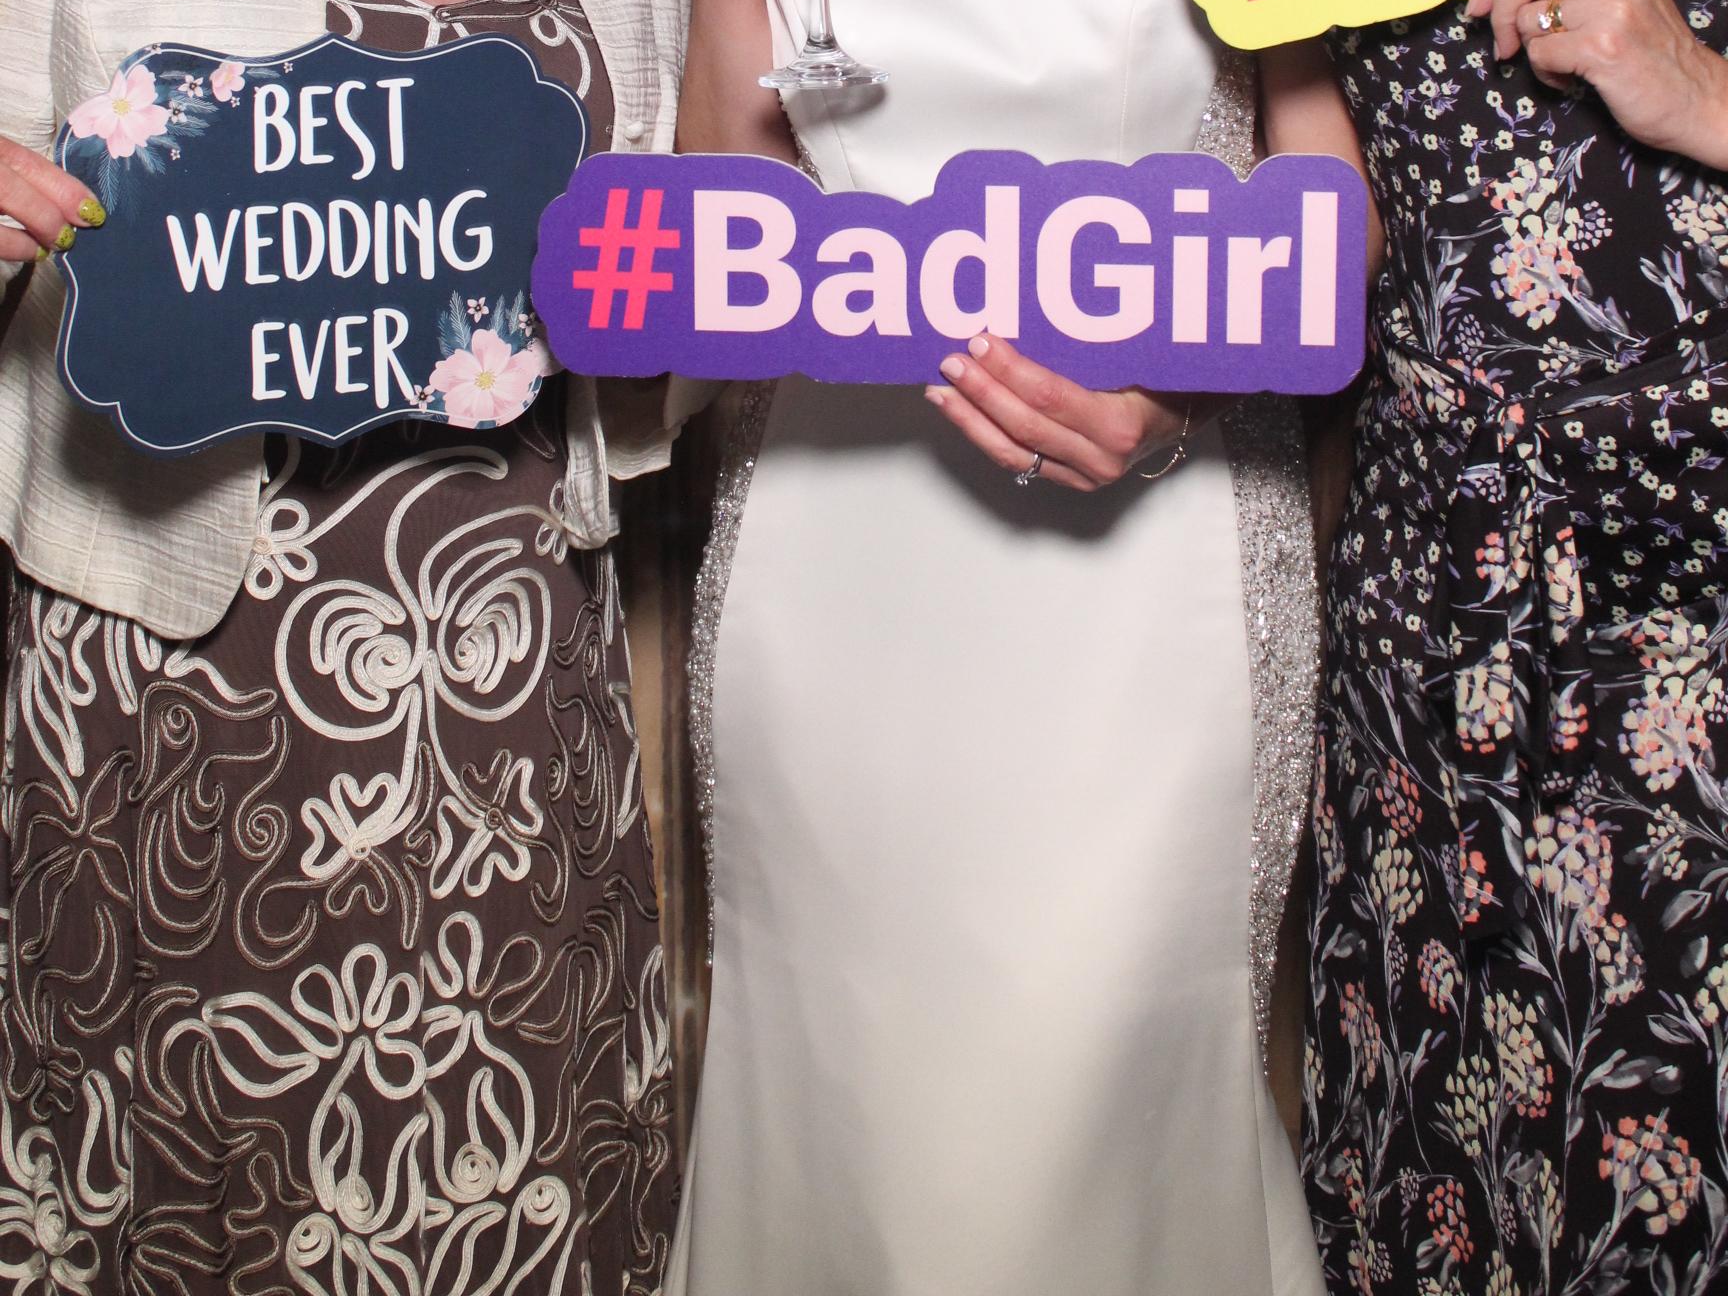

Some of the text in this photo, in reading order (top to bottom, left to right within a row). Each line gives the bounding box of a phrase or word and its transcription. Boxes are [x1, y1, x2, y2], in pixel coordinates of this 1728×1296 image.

[254, 77, 415, 180] BEST
[166, 189, 494, 293] WEDDING
[572, 185, 1339, 346] #BadGirl
[251, 308, 416, 408] EVER
